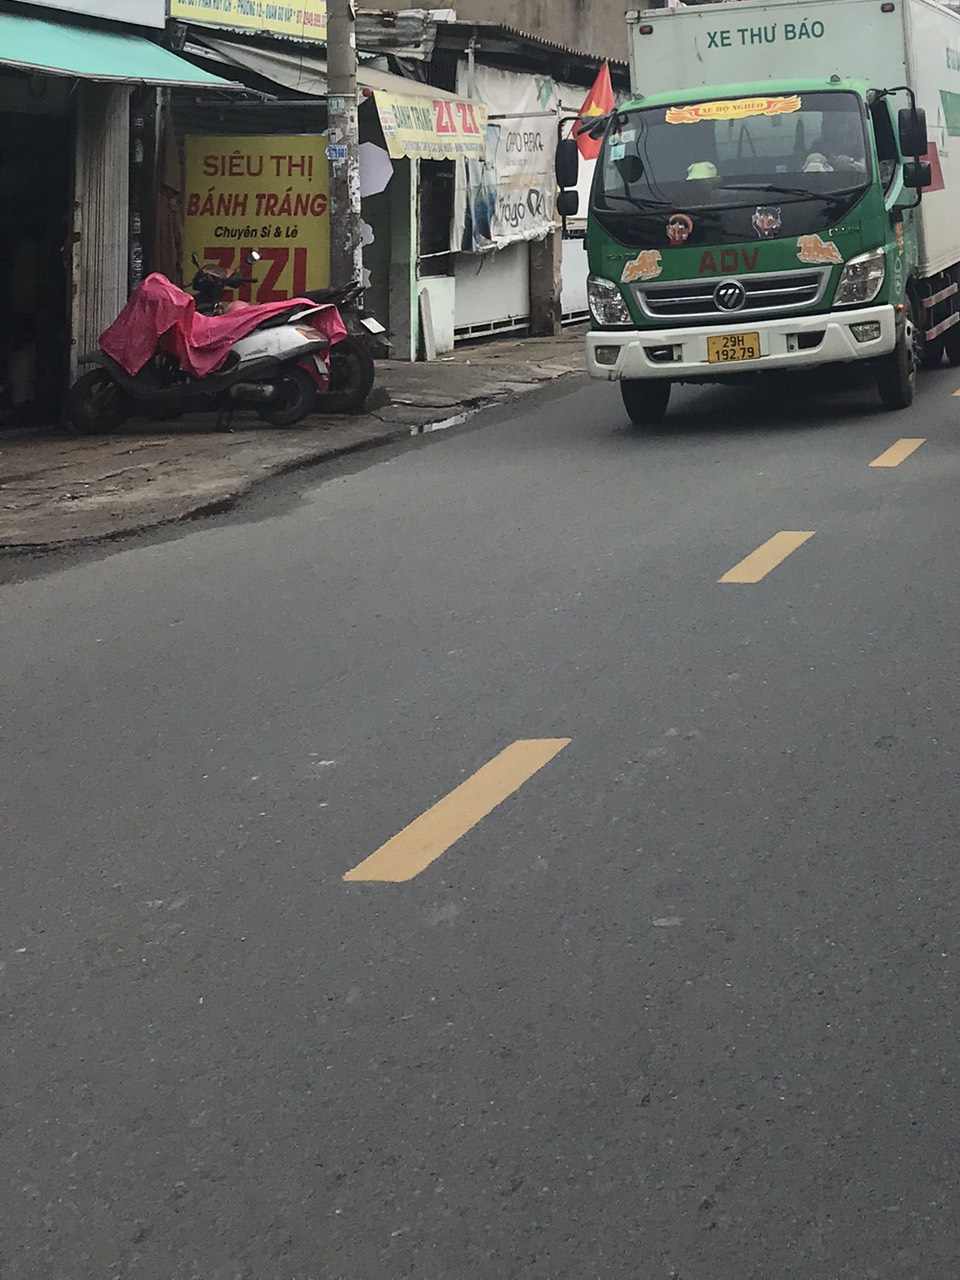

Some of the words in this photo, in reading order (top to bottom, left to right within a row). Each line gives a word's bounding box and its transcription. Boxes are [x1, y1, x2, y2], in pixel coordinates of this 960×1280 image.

[707, 30, 732, 48] XE
[737, 23, 777, 45] THƯ
[784, 17, 825, 40] BÁO
[433, 100, 457, 137] ZI
[456, 102, 480, 137] ZI
[203, 150, 264, 177] SIÊU
[270, 155, 313, 182] THỊ
[186, 186, 249, 216] BÁNH
[255, 186, 328, 217] TRÁNG
[214, 225, 258, 240] Chuyên
[273, 226, 282, 238] &
[699, 248, 759, 273] ADV
[715, 347, 755, 361] 192.79
[722, 336, 745, 348] 29H
